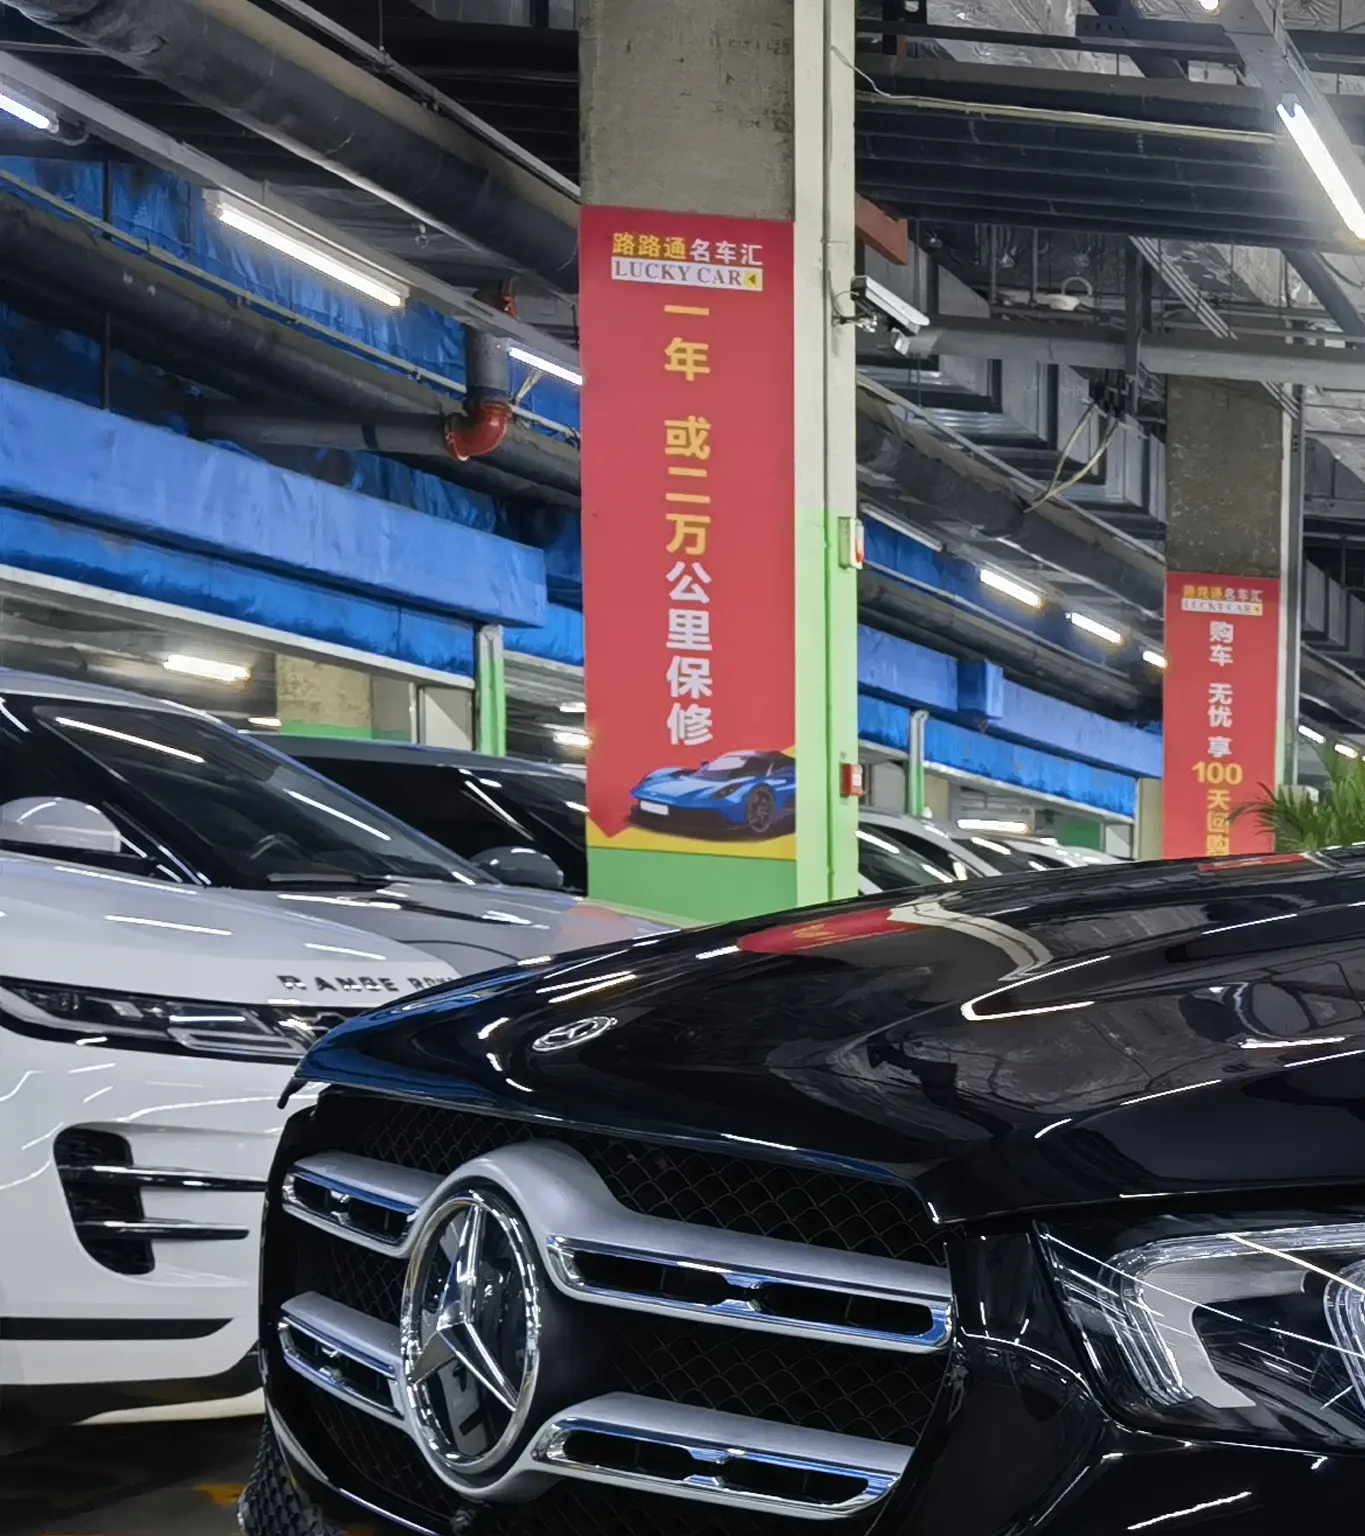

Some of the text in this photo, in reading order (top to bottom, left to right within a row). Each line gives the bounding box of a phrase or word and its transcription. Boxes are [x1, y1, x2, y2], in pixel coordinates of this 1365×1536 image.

[612, 232, 763, 265] 路路通名车汇
[615, 260, 742, 286] LUCKY CAR
[664, 304, 713, 746] 一年 或二万公里保修
